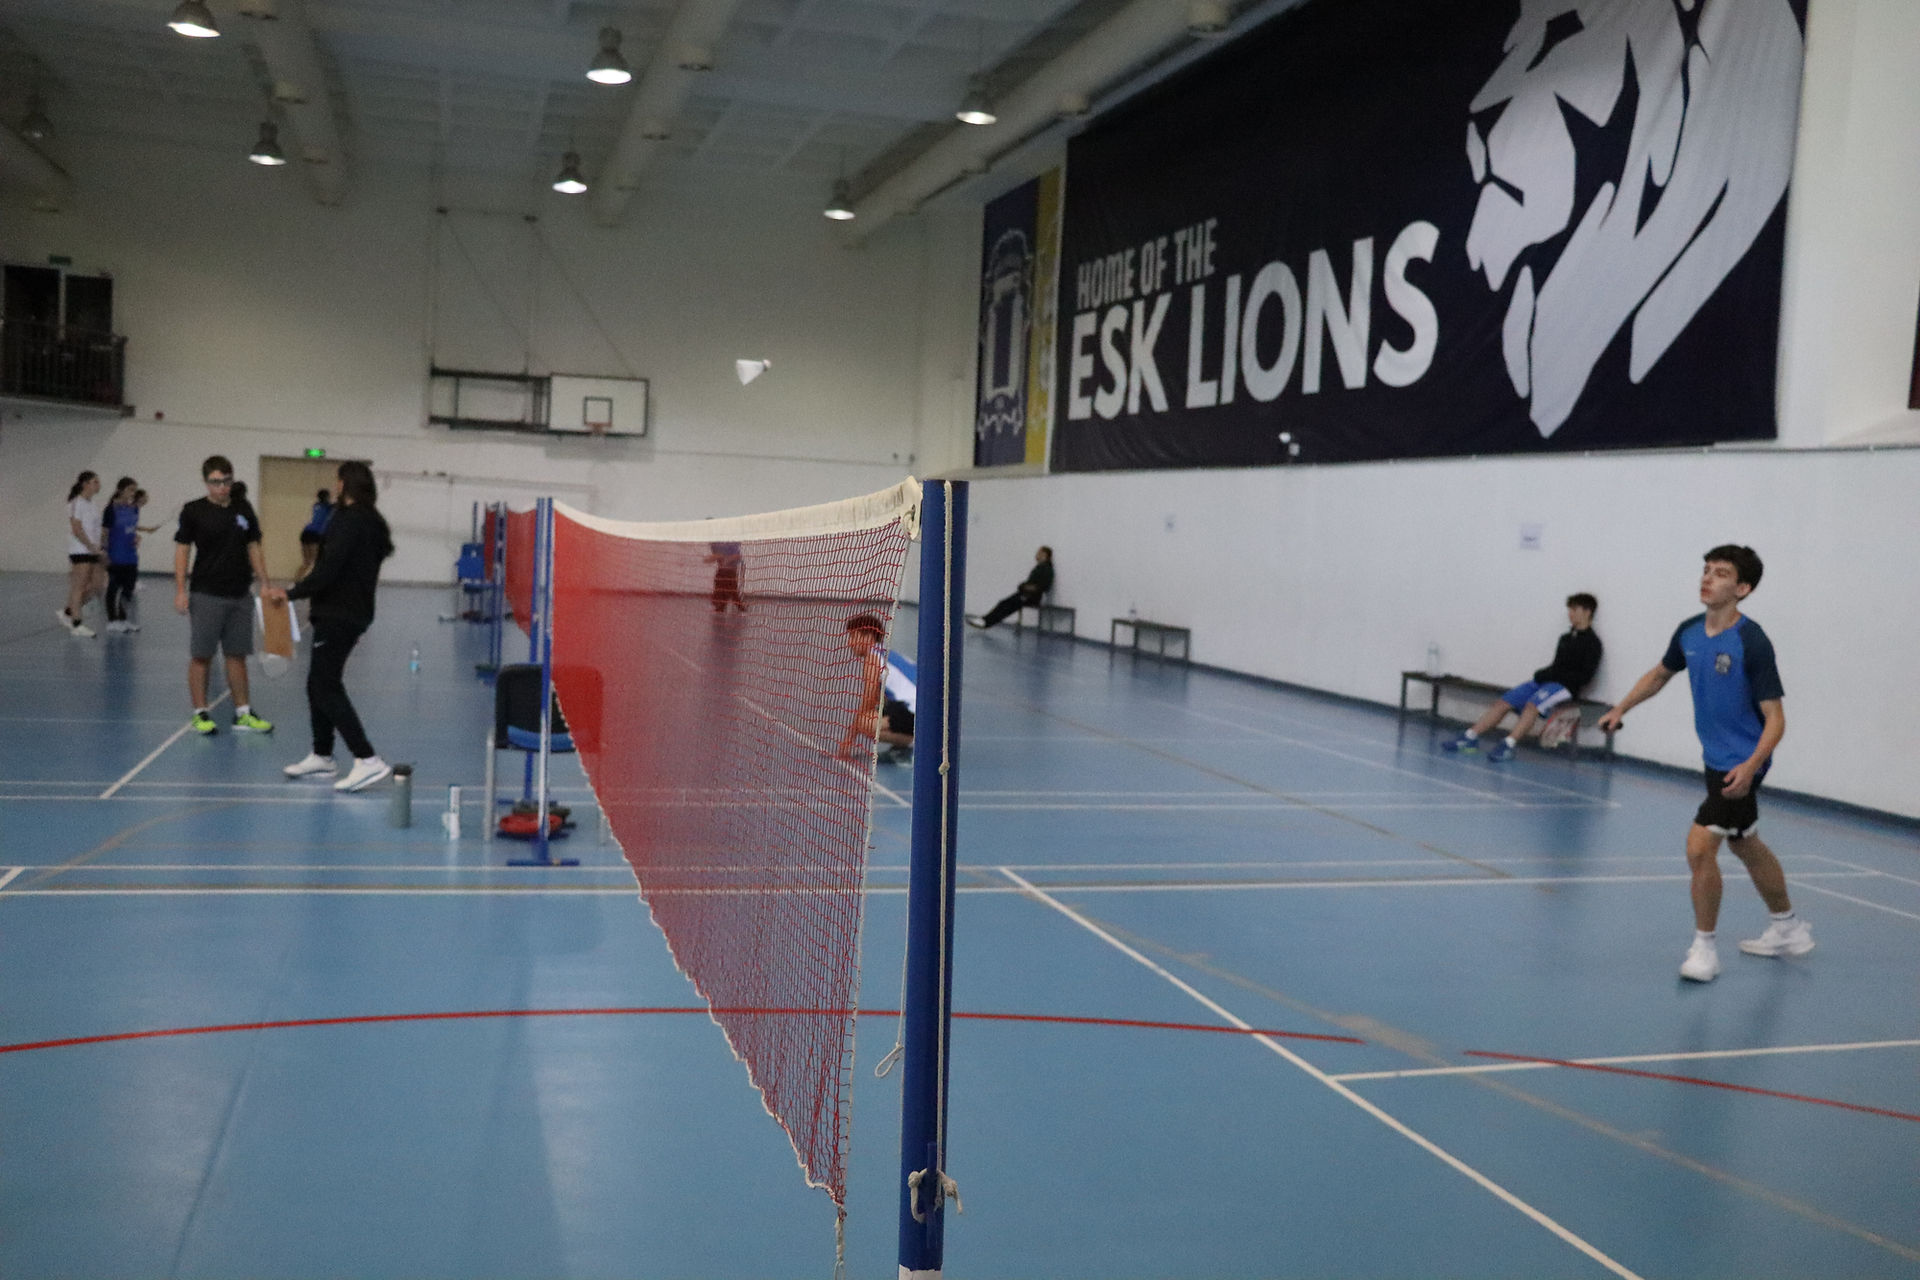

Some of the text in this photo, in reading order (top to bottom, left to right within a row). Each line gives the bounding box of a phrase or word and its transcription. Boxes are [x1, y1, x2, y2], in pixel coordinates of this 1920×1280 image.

[1068, 220, 1440, 420] ESK LIONS
[1077, 217, 1217, 311] HOME OF THE
